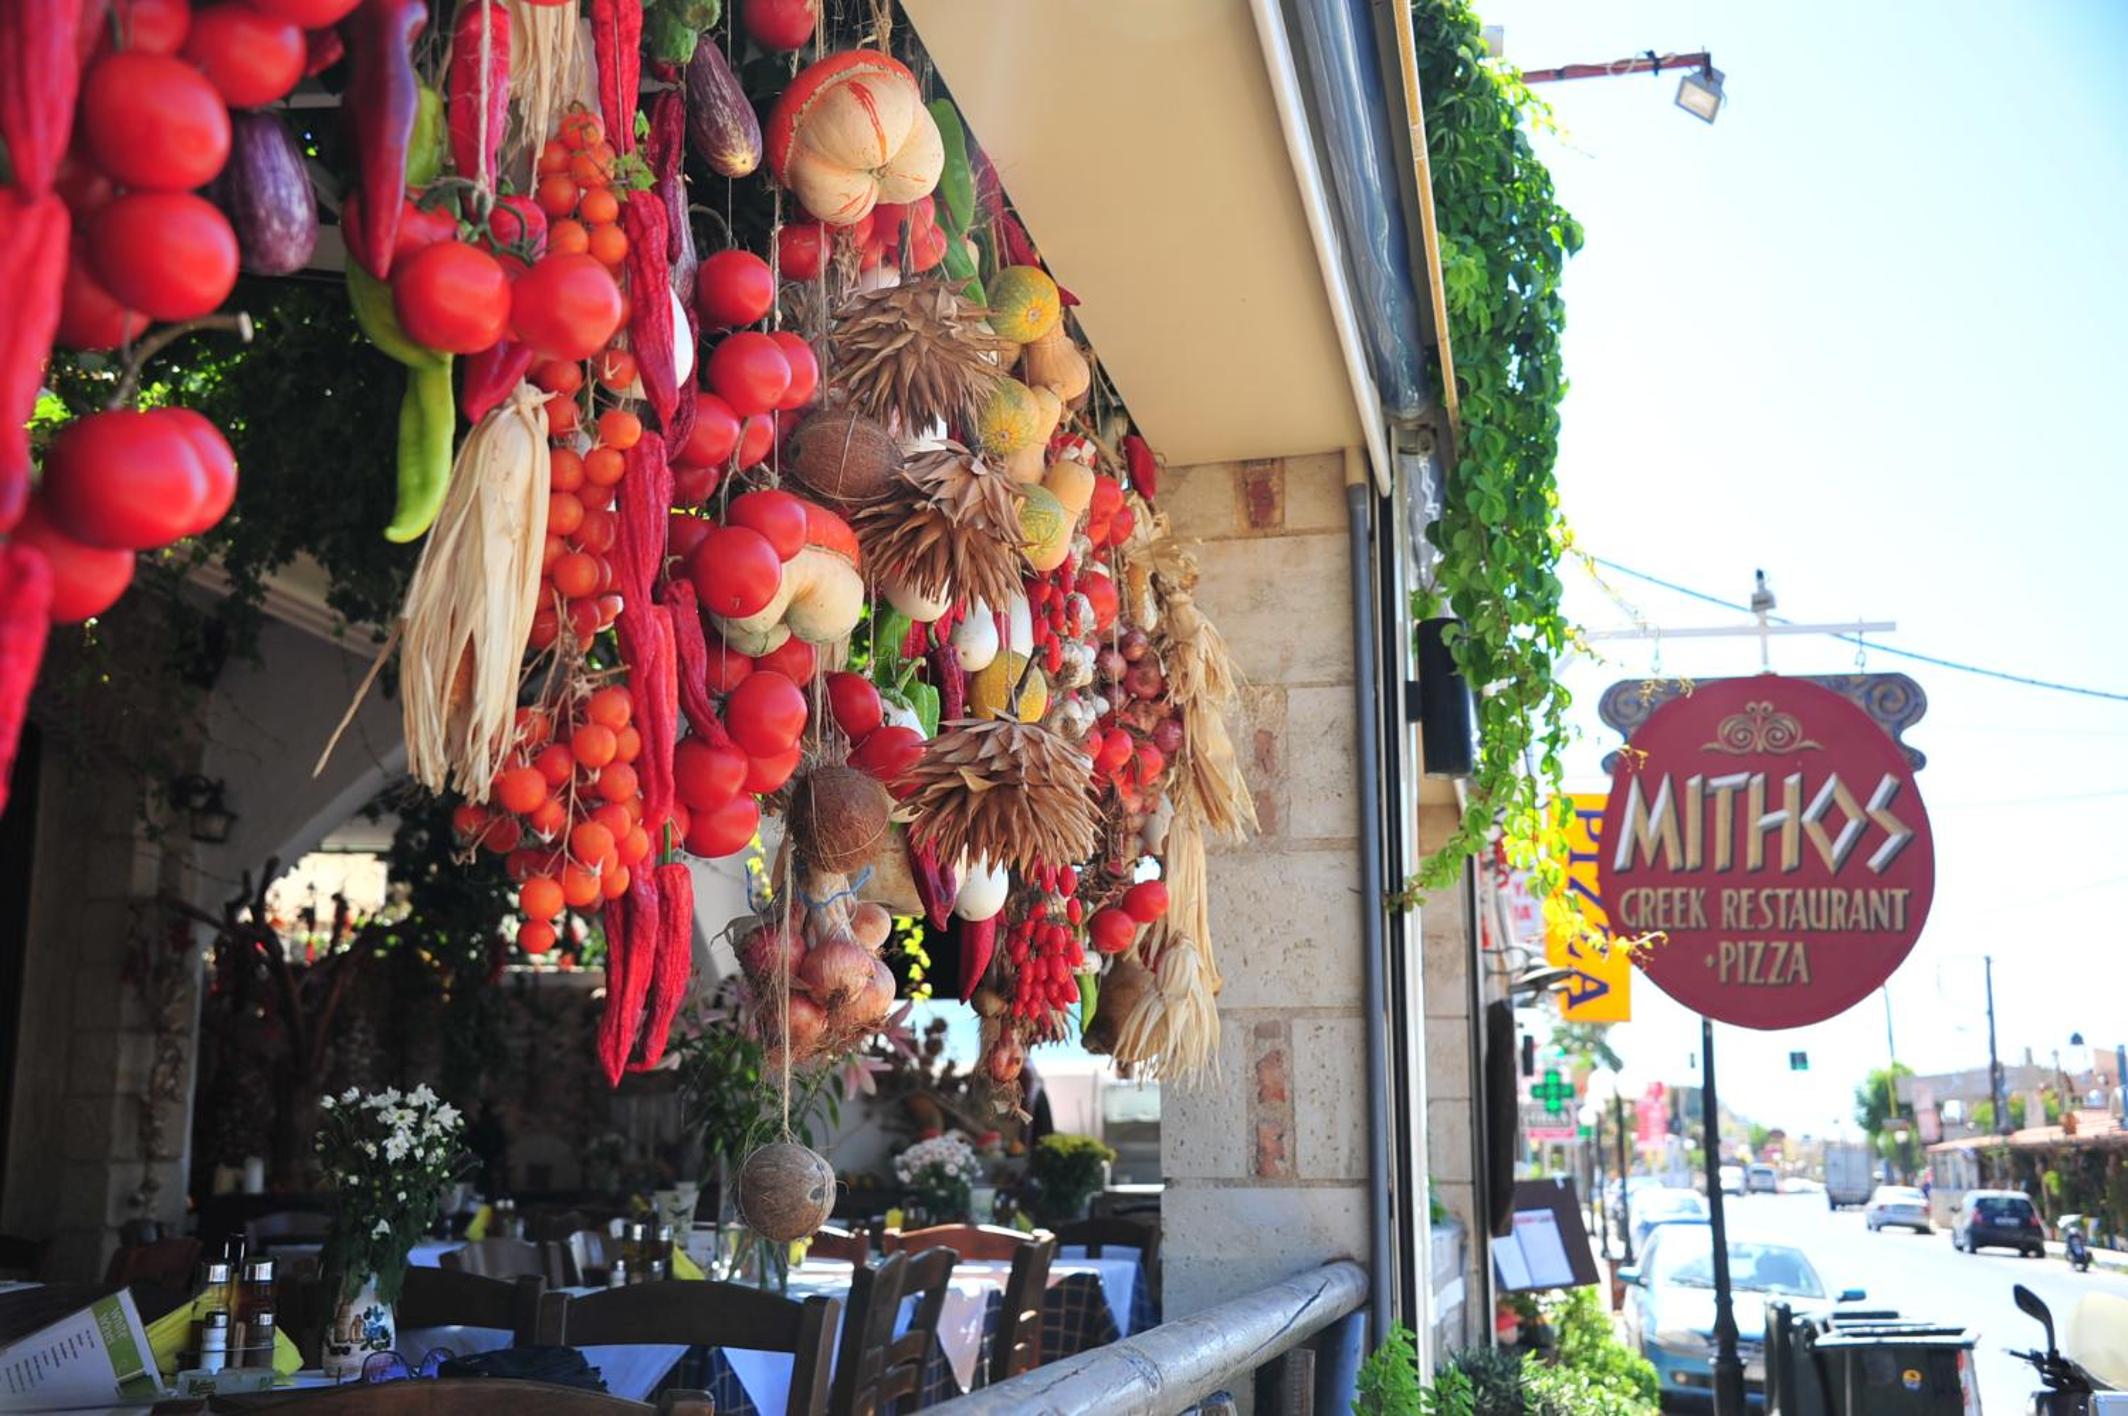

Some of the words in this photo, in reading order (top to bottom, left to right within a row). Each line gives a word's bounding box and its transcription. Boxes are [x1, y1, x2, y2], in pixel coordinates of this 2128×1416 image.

[1613, 771, 1914, 874] MITHOS
[1619, 886, 1707, 929] GREEK
[1720, 887, 1909, 931] RESTAURANT
[1718, 940, 1810, 985] PIZZA
